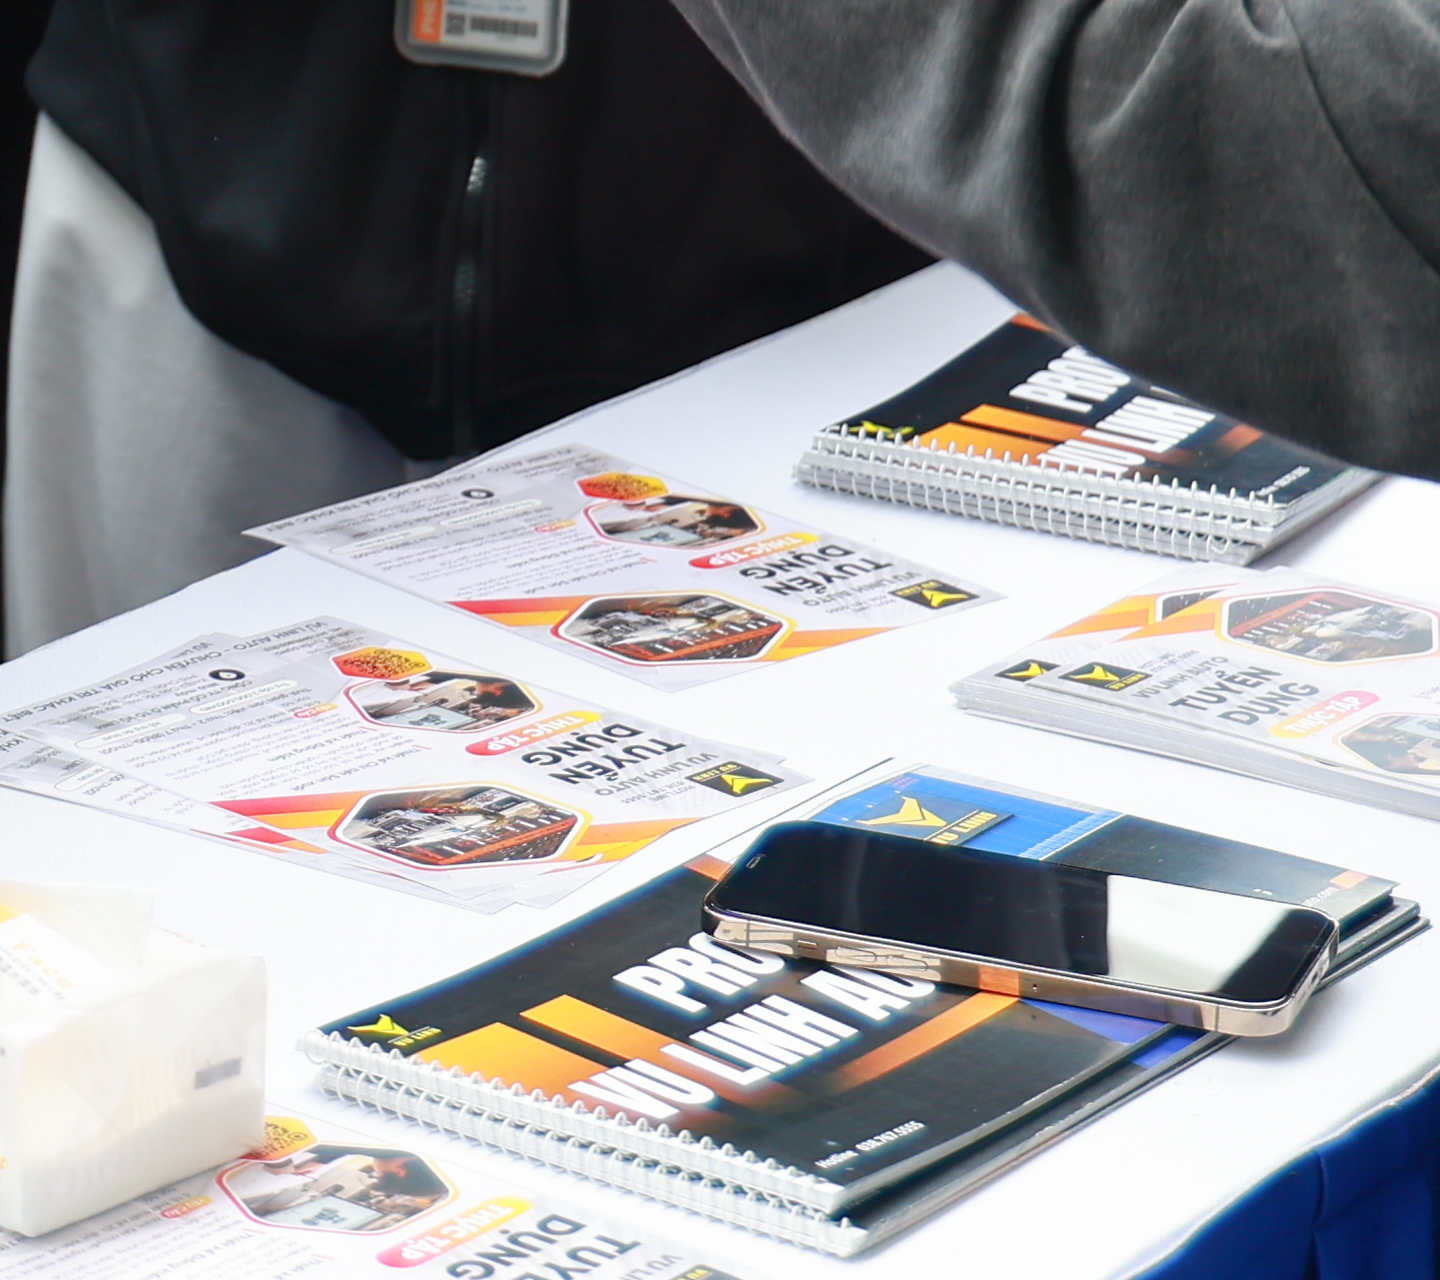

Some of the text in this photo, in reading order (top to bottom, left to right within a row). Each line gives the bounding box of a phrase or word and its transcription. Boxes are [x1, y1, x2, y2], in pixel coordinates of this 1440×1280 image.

[1039, 398, 1210, 472] VU LINH
[710, 536, 808, 567] THỰC TẬP
[740, 545, 852, 578] DỤNG
[764, 559, 890, 595] TUYỂN
[233, 638, 270, 649] AUTO
[1131, 656, 1228, 698] VU LINH AUTO
[1170, 667, 1278, 709] TUYỂN
[1219, 683, 1317, 724] DỤNG
[1283, 696, 1360, 732] THỰC TẬP
[488, 716, 583, 750] THỰC TẬP
[522, 724, 640, 765] DỤNG
[551, 739, 683, 783] TUYỂN
[594, 753, 717, 795] VU LINH AUTO
[618, 935, 780, 1010] PRO
[572, 958, 932, 1117] VU LINH AU
[815, 1121, 923, 1168] Hotline 038.767.5555
[394, 1204, 512, 1259] THỰC TẬP
[447, 1213, 587, 1280] DỤNG
